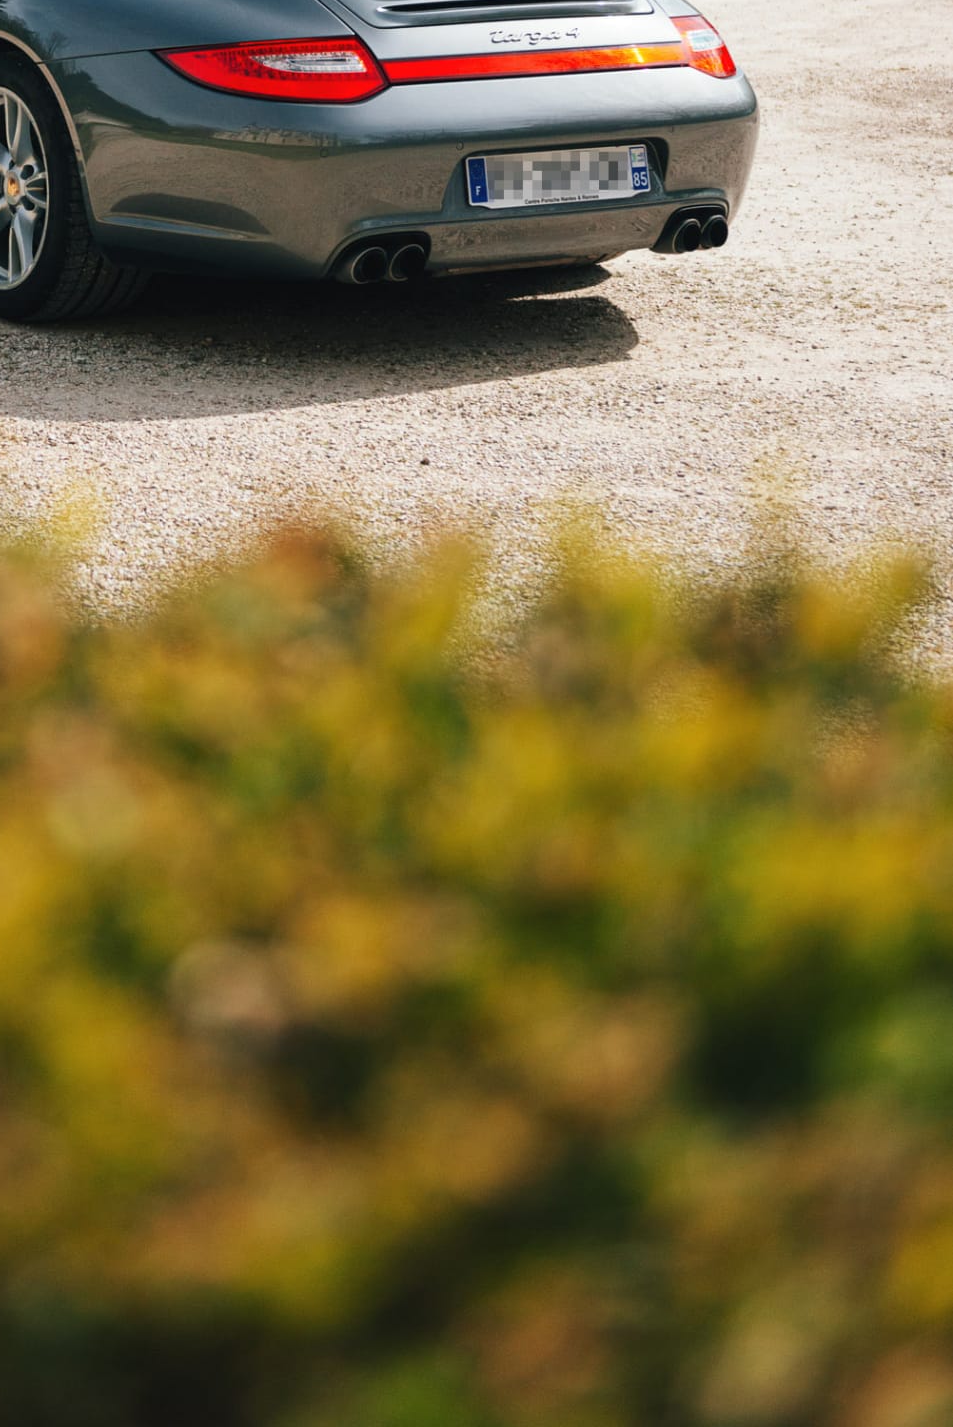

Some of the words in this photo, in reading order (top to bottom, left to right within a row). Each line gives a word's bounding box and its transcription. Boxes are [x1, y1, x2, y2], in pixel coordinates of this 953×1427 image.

[489, 31, 561, 46] Targa
[565, 27, 579, 39] 4
[633, 172, 648, 187] 85
[475, 185, 481, 196] F
